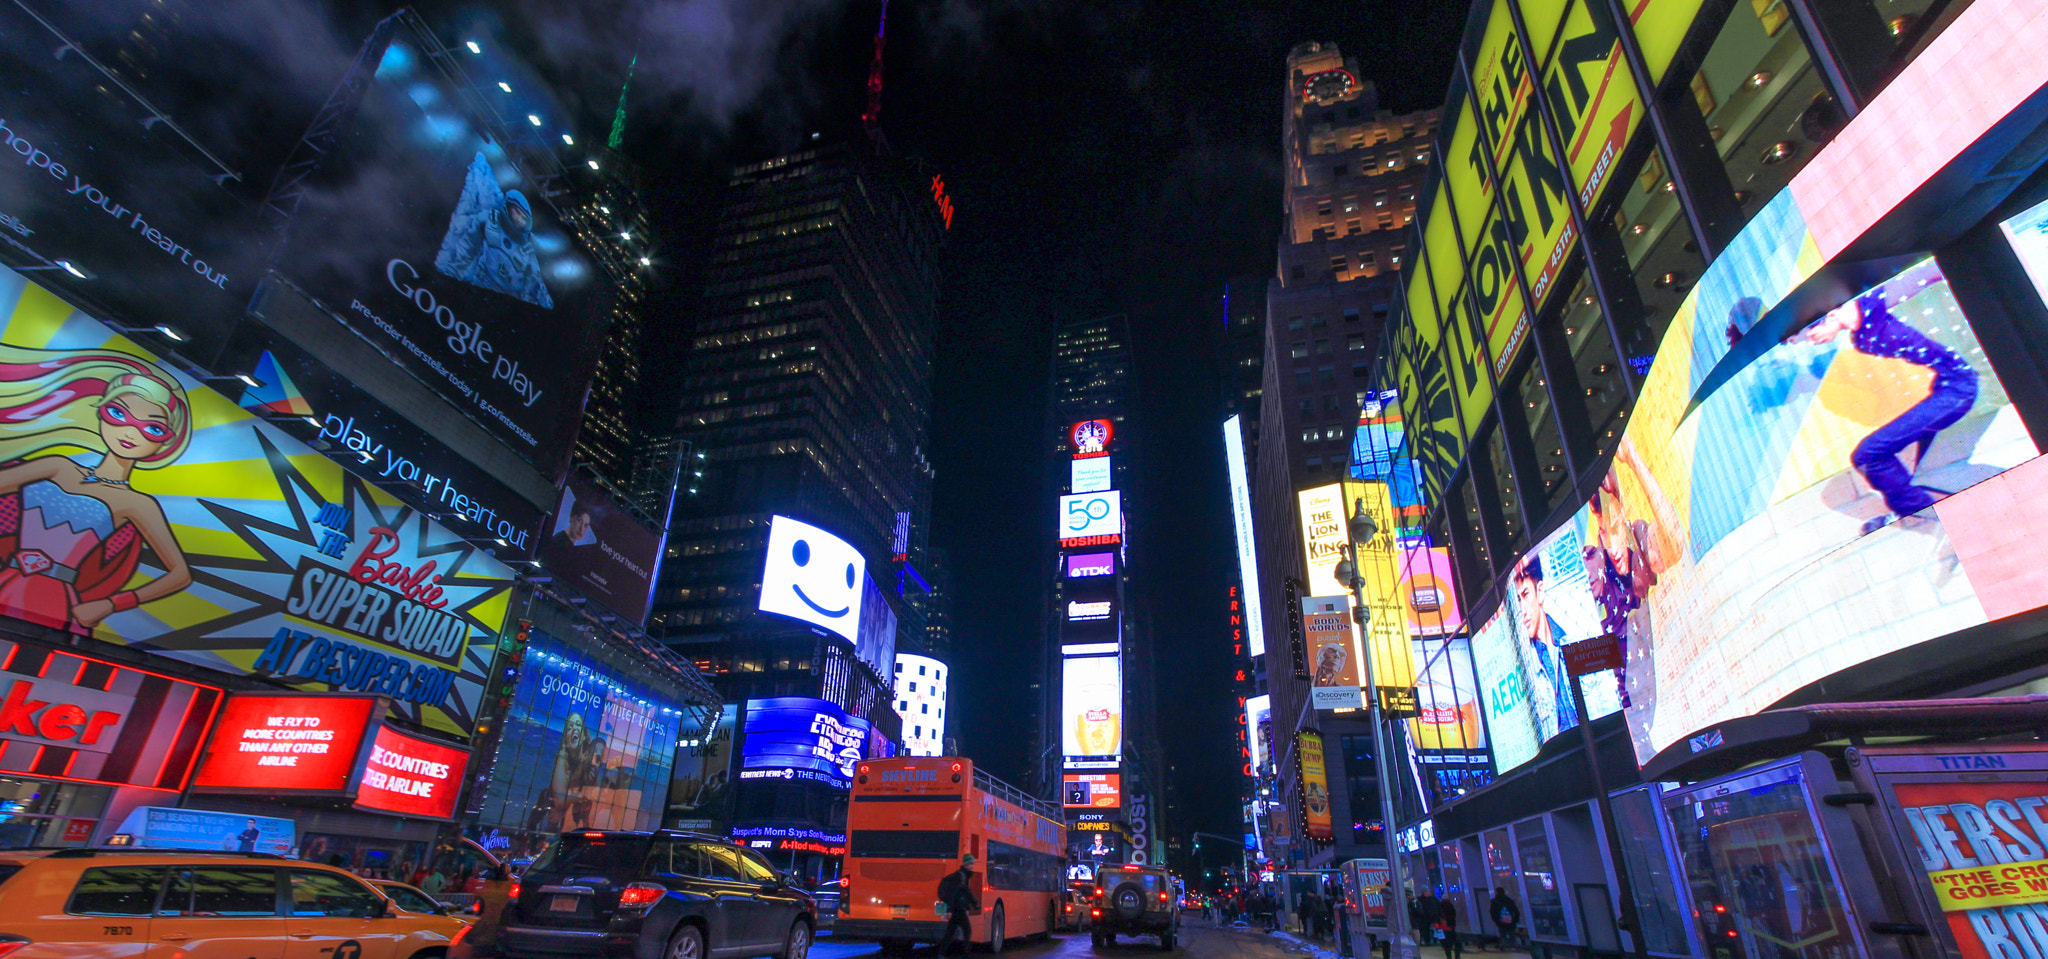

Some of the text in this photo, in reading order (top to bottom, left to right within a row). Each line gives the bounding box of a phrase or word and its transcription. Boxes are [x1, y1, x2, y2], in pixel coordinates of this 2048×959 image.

[931, 174, 954, 230] H&M
[66, 176, 131, 219] your
[131, 212, 193, 265] heart
[193, 260, 230, 290] out
[1496, 140, 1614, 375] ENTRANCE ON 45TH STREET
[386, 259, 543, 407] Google play
[351, 299, 402, 341] pre-order
[448, 372, 474, 398] today
[1072, 450, 1110, 460] TOSHIBA
[318, 412, 530, 551] play your heart out
[312, 501, 353, 533] JOIN
[1310, 510, 1333, 522] THE
[1308, 523, 1339, 541] LION
[317, 528, 350, 559] THE
[1060, 533, 1121, 548] TOSHIBA
[348, 526, 448, 610] Barbie
[1080, 566, 1111, 576] TDK
[287, 567, 466, 658] SUPER SQUAD
[1307, 624, 1350, 632] WORLDS
[1313, 617, 1341, 625] BODY
[1229, 586, 1242, 655] ERNST
[1236, 670, 1245, 681] &
[1574, 647, 1611, 663] ANYTIME
[253, 627, 456, 707] AT BESUPER.COM
[541, 674, 601, 711] goodbye
[0, 680, 121, 745] ker
[603, 702, 638, 724] winter
[267, 716, 320, 727] WE FLY TO
[242, 729, 335, 740] MORE COUNTRIES
[239, 742, 329, 753] THAN ANY OTHER
[1300, 737, 1322, 752] BUBBA
[257, 755, 299, 766] AIRLINE
[1303, 750, 1321, 763] GUMP
[1936, 755, 2006, 770] TITAN
[382, 751, 450, 779] COUNTRIES
[797, 770, 814, 779] THE
[881, 770, 938, 782] SKYLINE
[384, 775, 435, 798] AIRLINE
[150, 812, 167, 822] FOR
[764, 827, 786, 836] Mom
[1077, 822, 1110, 831] COMPANIES
[1903, 794, 2048, 870] JERSE
[1360, 871, 1390, 887] JERSEY
[1949, 881, 2021, 900] GOES
[103, 926, 133, 936] 7870
